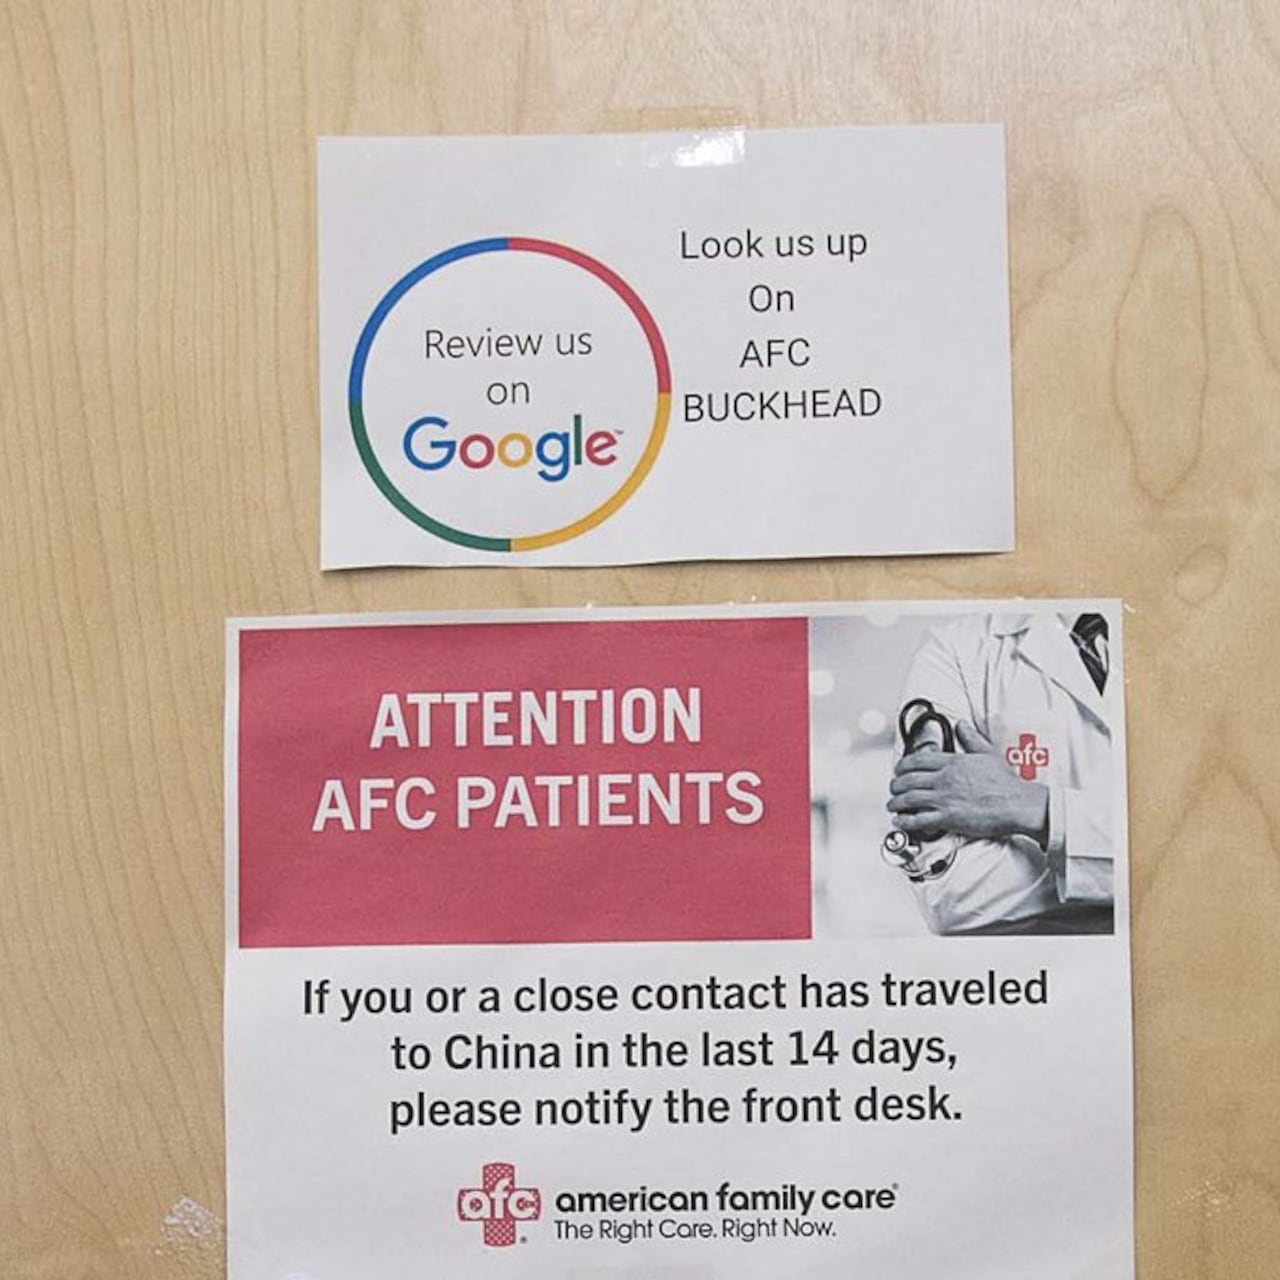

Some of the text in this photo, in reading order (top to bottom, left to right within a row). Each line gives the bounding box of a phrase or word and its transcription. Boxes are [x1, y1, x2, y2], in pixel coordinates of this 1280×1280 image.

[682, 229, 867, 262] Look us up
[749, 285, 794, 312] On
[426, 328, 592, 358] Review us
[740, 338, 809, 368] AFC
[487, 382, 529, 405] on
[685, 389, 881, 422] BUCKHEAD
[403, 415, 616, 481] Google
[371, 688, 700, 748] ATTENTION
[313, 772, 763, 831] AFC PATIENTS
[305, 970, 1047, 1022] If you or a close contact has traveled
[391, 1029, 956, 1071] to China in the last 14 days,
[391, 1085, 961, 1134] please notify the front desk.
[461, 1178, 539, 1220] afc
[556, 1182, 895, 1215] american family care
[554, 1218, 836, 1244] The Right Care. Right Now.
